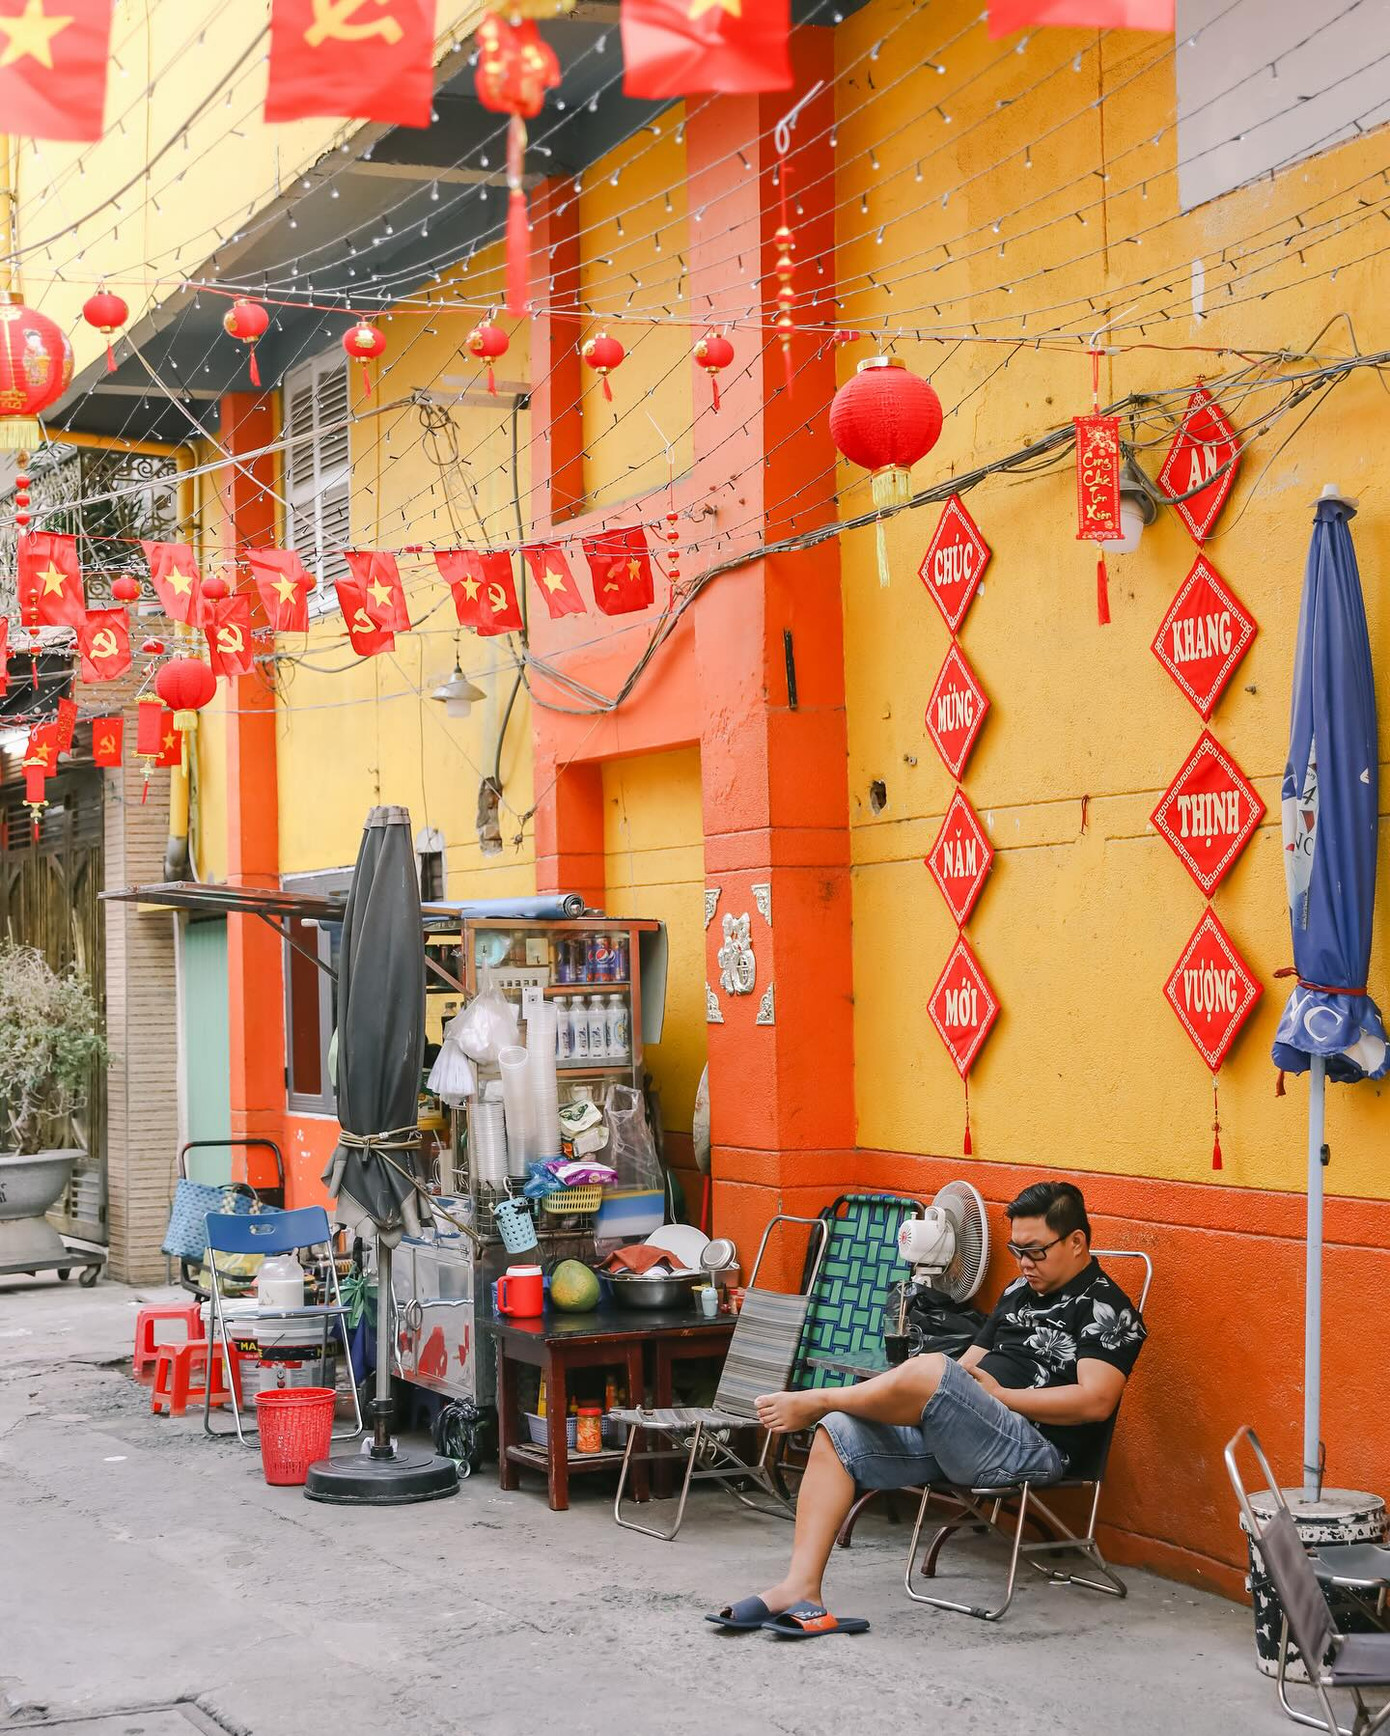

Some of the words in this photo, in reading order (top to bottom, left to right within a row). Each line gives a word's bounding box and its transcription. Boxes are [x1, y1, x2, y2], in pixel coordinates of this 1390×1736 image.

[1187, 441, 1217, 492] AN
[934, 533, 973, 586] CHÚC
[1171, 611, 1232, 664] KHANG
[937, 682, 974, 734] MỪNG
[1177, 791, 1240, 848] THỊNH
[943, 828, 978, 878] NĂM
[944, 977, 978, 1027] MỚI
[1183, 958, 1238, 1022] VƯỢNG
